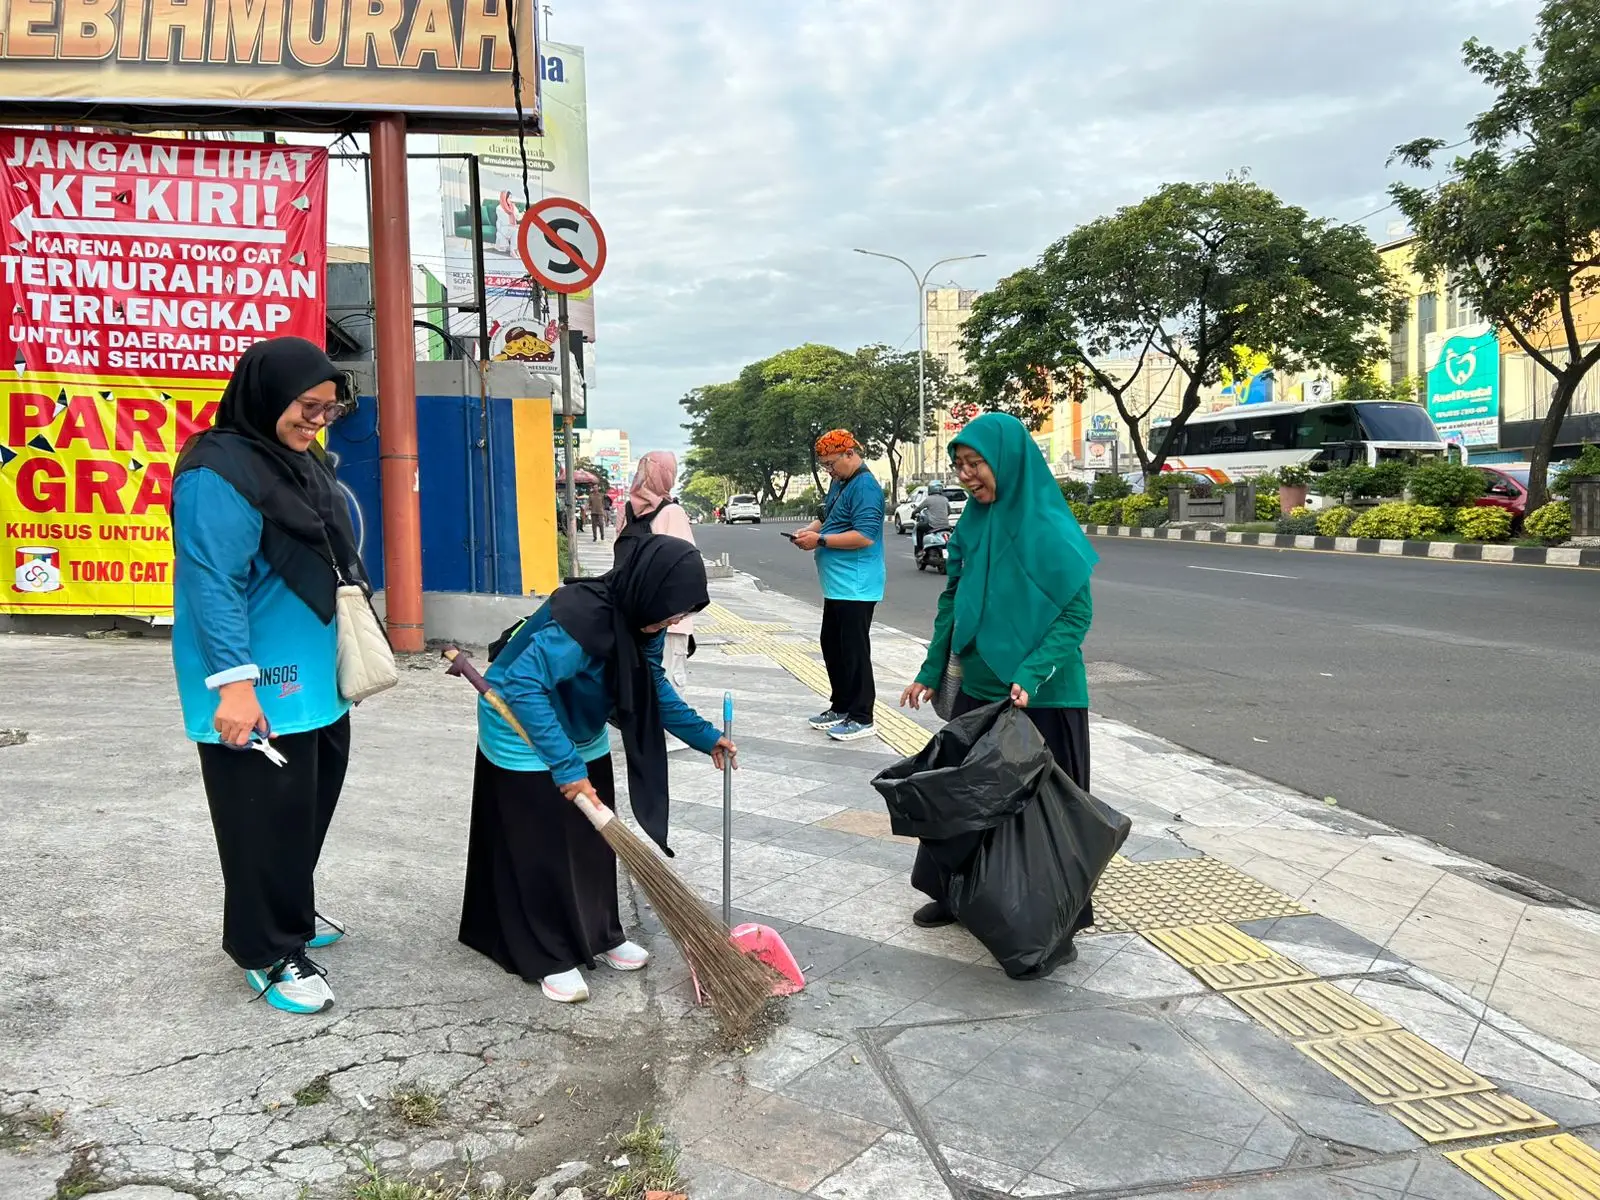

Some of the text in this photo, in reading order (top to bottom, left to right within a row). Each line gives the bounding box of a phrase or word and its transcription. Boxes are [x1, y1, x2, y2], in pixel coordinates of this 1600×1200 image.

[0, 0, 513, 72] EBIHMURAH
[6, 136, 312, 182] JANGAN LIHAT
[39, 174, 279, 228] KE KIRI!
[35, 237, 282, 265] KARENA ADA TOKO CAT
[544, 218, 583, 274] S
[1, 255, 317, 299] TERMURAH DAN
[26, 291, 291, 332] TERLENGKAP
[8, 325, 99, 347] UNTUK
[108, 331, 213, 353] DAERAH
[45, 347, 99, 367] DAN
[6, 522, 170, 542] KHUSUS UNTUK
[69, 560, 169, 583] TOKO CAT
